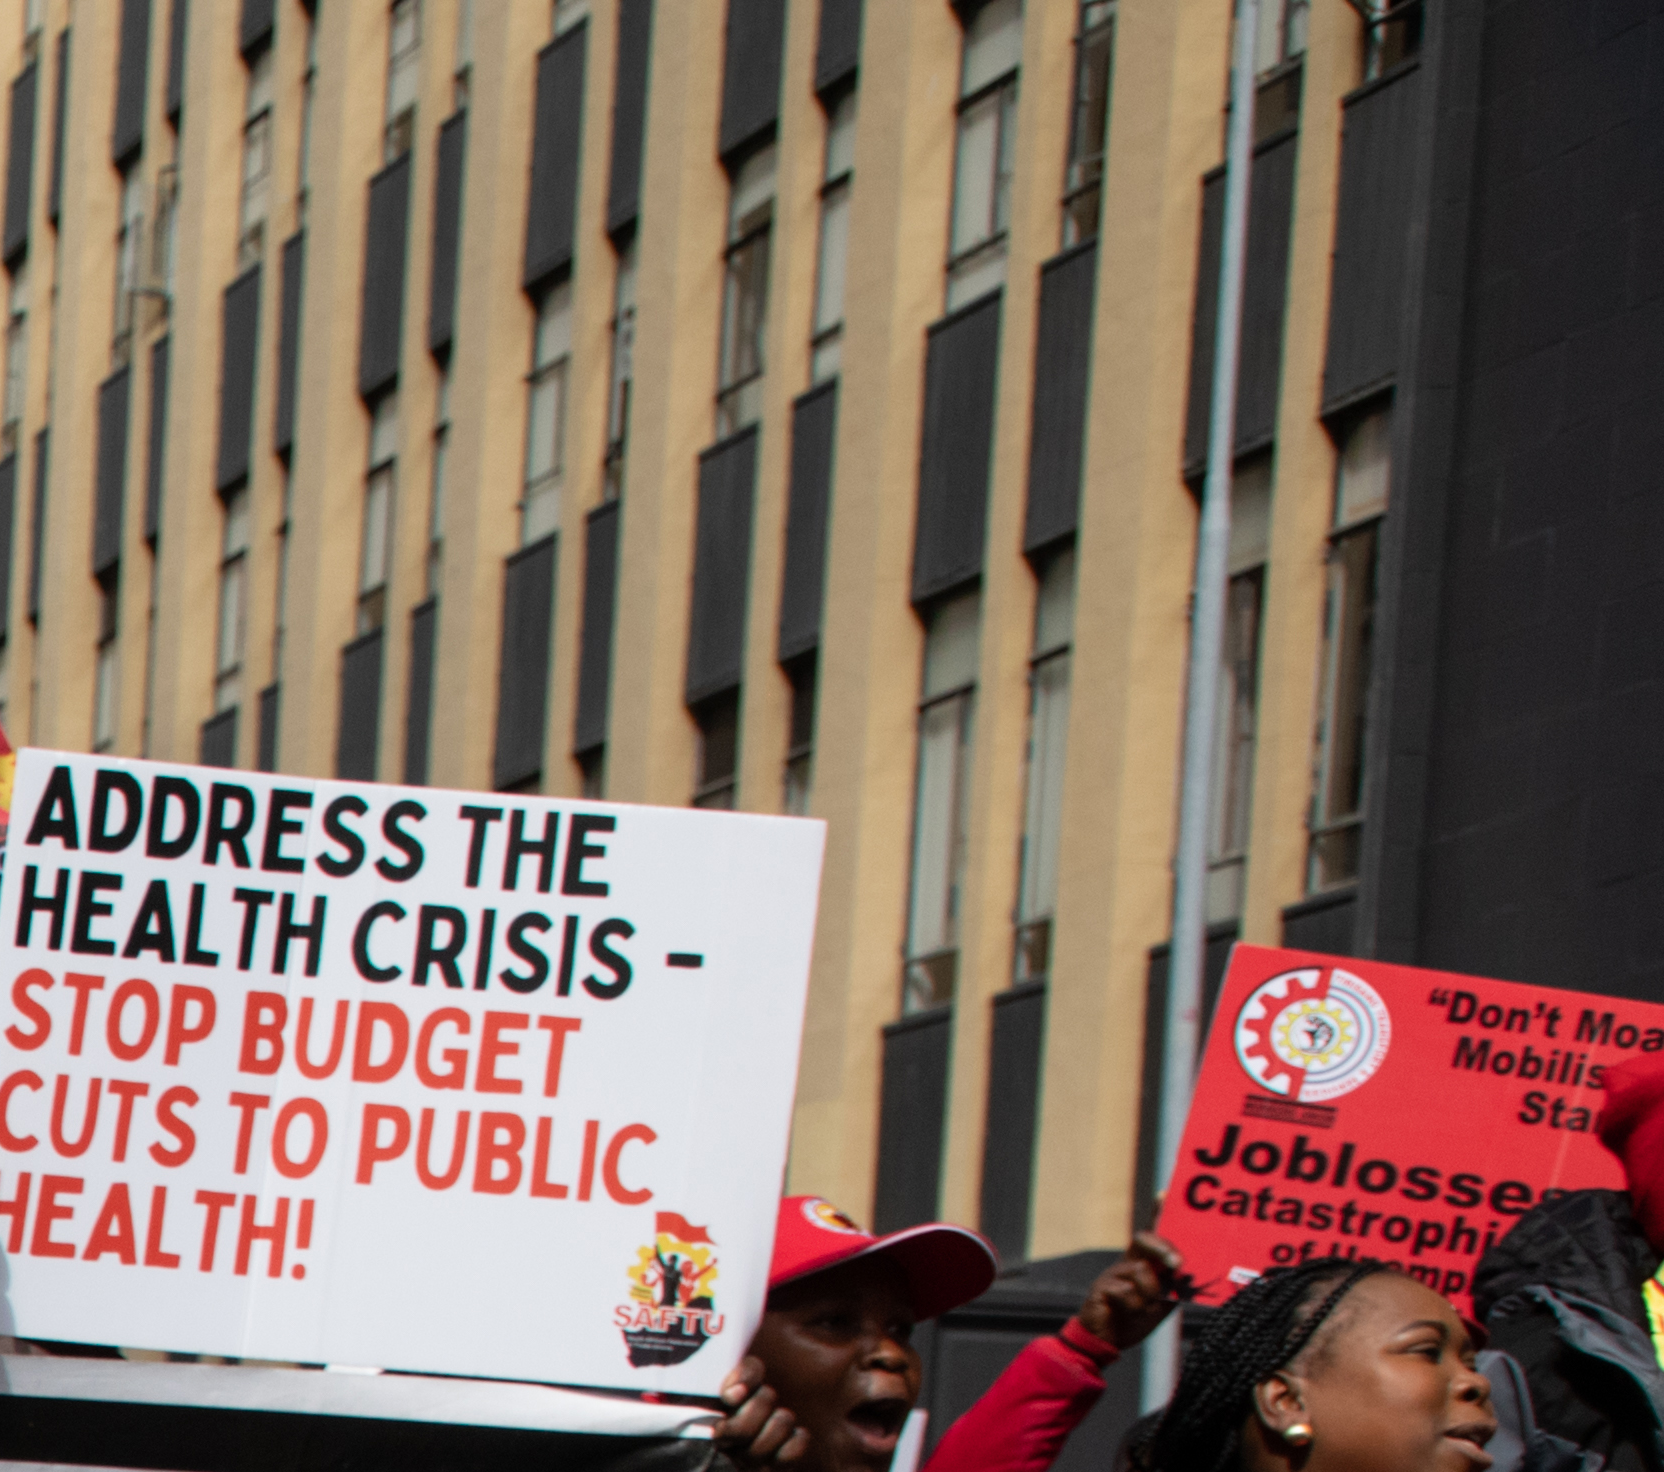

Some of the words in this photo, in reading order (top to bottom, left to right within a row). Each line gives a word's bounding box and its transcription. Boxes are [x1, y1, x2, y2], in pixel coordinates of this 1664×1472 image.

[24, 764, 428, 882] ADDRESS
[458, 803, 620, 899] THE
[13, 865, 327, 977] HEALTH
[352, 900, 635, 1001] CRISIS
[4, 968, 216, 1066] STOP
[237, 989, 583, 1099] BUDGET
[1452, 1036, 1607, 1089] Mobilis
[1574, 1009, 1664, 1052] Moa
[229, 1092, 330, 1179] TO
[354, 1102, 659, 1205] PUBLIC
[1183, 1175, 1509, 1256] Catastrophi
[613, 1304, 725, 1335] SAFTU
